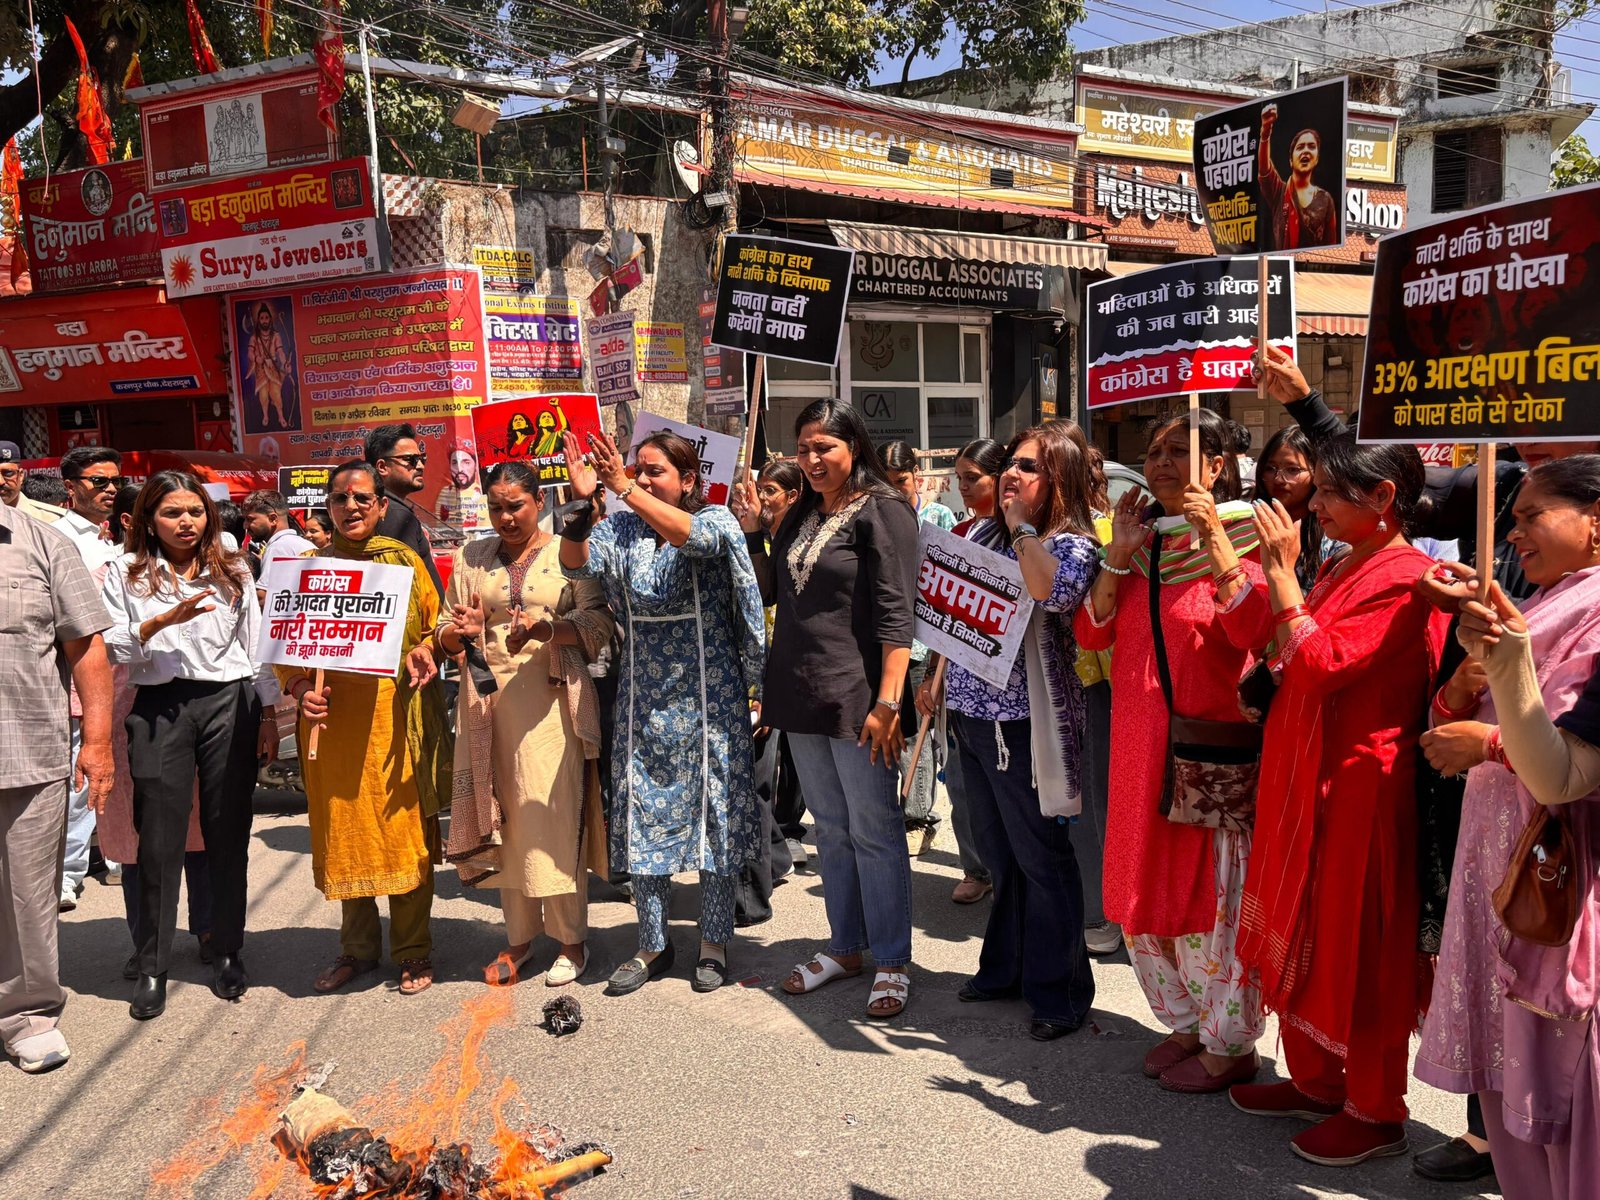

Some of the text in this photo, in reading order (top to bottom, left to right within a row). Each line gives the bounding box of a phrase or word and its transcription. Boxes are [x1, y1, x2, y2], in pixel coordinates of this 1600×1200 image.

[761, 105, 794, 118] DUGGAL
[1101, 102, 1169, 136] महेश्वरी
[737, 116, 813, 148] AMAR
[937, 141, 1053, 176] ASSOCIATES
[1202, 124, 1250, 164] कांग्रेस
[167, 168, 188, 182] हनुमान
[190, 162, 207, 175] मन्दिर
[840, 156, 970, 180] CHARTERED ACCOUNTANTS
[1203, 155, 1255, 191] पहचान
[189, 173, 328, 227] बड़ा हनुमान मन्दिर
[1346, 187, 1402, 229] Shop
[29, 192, 157, 262] हनुमान मन्दि
[1212, 216, 1257, 245] अपमान
[1416, 217, 1551, 265] नारी शक्ति के साथ
[38, 264, 75, 281] TATTOOS
[76, 263, 86, 274] BY
[89, 259, 118, 273] ARORA
[199, 247, 267, 279] Surya
[271, 238, 368, 269] Jewellers
[739, 245, 813, 270] कांग्रेस का हाथ
[728, 262, 831, 292] नारी शक्ति के खिलाफ
[872, 256, 943, 283] DUGGAL
[948, 262, 1043, 290] ASSOCIATES
[1403, 252, 1569, 308] कांग्रेस का धोखा
[349, 278, 447, 302] श्री परशुराम जन्मोत्सव
[506, 298, 574, 311] Exams Institute
[732, 290, 810, 318] जनता नहीं
[857, 281, 1009, 303] CHARTERED ACCOUNTANTS
[1097, 275, 1282, 315] महिलाओं के अधिकरों
[317, 298, 451, 326] भगवान श्री परशुराम जी के
[727, 309, 807, 341] करेगी माफ
[1116, 317, 1141, 338] की
[1146, 314, 1175, 332] जब
[1182, 305, 1219, 327] बारी
[310, 316, 464, 345] पावन जन्मोत्सव के उपलक्ष्य में
[12, 330, 187, 381] हनुमान मन्दिर
[341, 340, 474, 361] समाज उत्थान परिषद द्वारा
[305, 371, 341, 384] विशाल
[342, 369, 361, 380] यज्ञ
[383, 360, 421, 376] धार्मिक
[423, 360, 476, 376] अनुष्ठान
[616, 361, 628, 372] SSC
[1100, 358, 1194, 393] कांग्रेस है
[1372, 360, 1419, 395] 33%
[1425, 350, 1530, 390] आरक्षण
[116, 381, 146, 392] करनपुर
[312, 390, 327, 401] का
[331, 385, 376, 398] आयोजन
[379, 382, 407, 395] किया
[411, 380, 426, 391] जा
[429, 379, 449, 390] रहा
[368, 407, 391, 418] रविवार
[863, 393, 891, 418] CA
[1394, 392, 1565, 427] को पास होने से रोका
[287, 495, 307, 504] आदत
[296, 487, 318, 495] कांग्रेस
[308, 570, 352, 592] कांग्रेस
[927, 544, 1020, 598] महिलाओं के अधिकारों का
[274, 590, 292, 612] की
[293, 594, 331, 612] आदत
[917, 561, 1016, 633] अपमान
[270, 612, 387, 642] नारी सम्मान
[915, 602, 995, 655] कांग्रेस है जिम्मेदार
[286, 641, 355, 659] की झूठी कहानी
